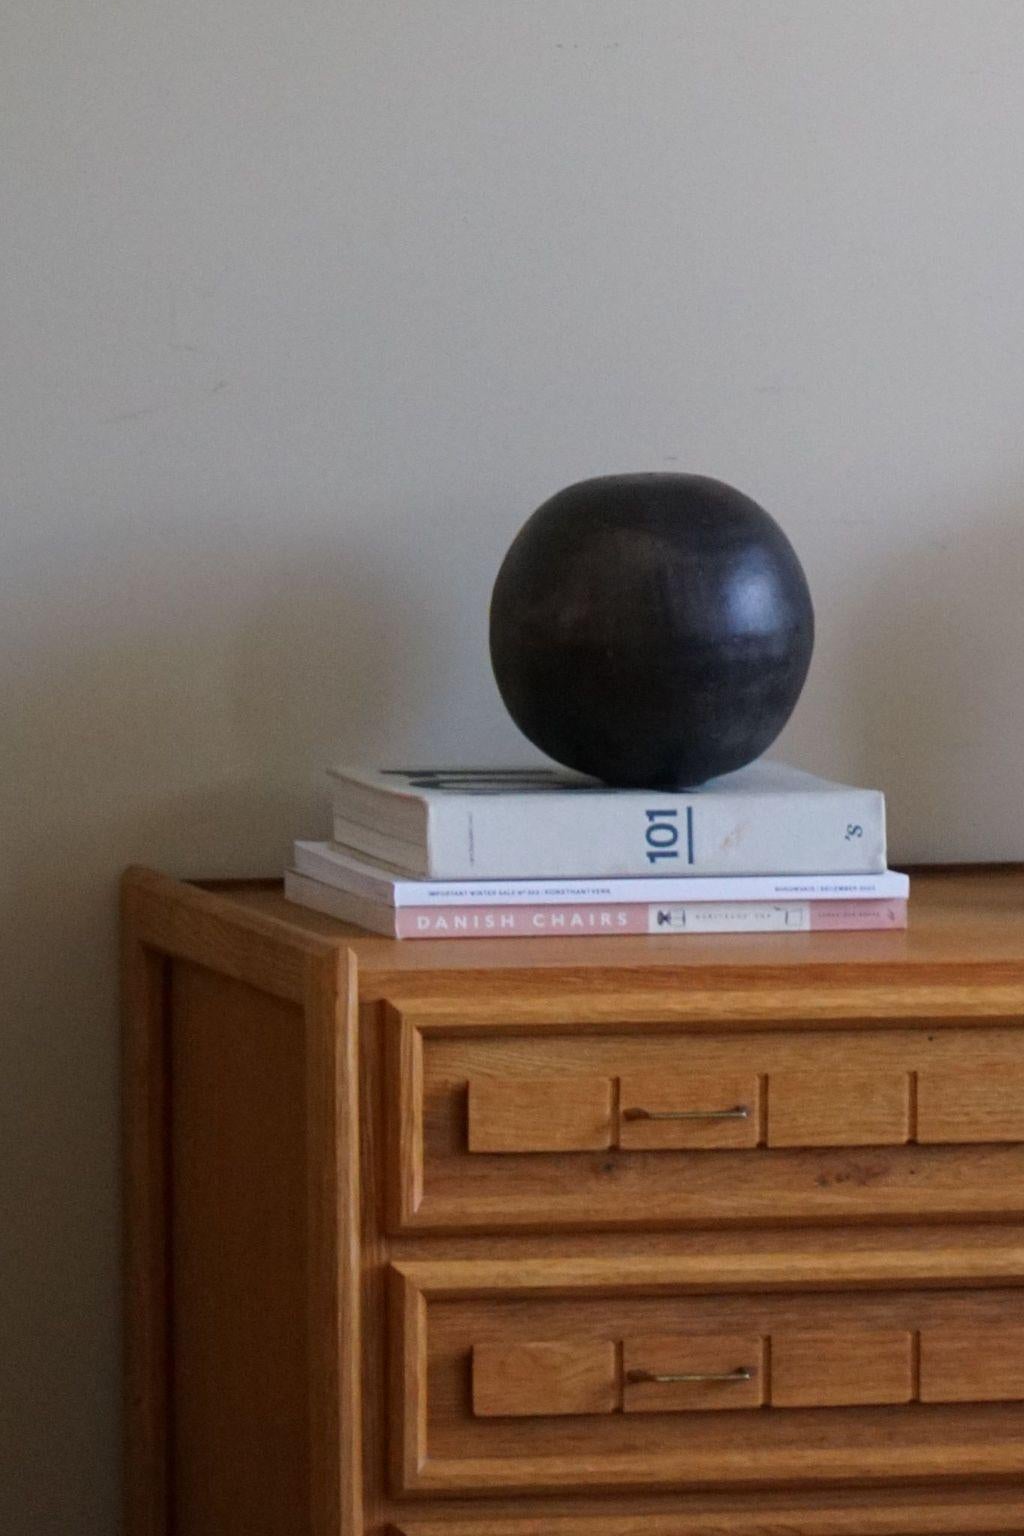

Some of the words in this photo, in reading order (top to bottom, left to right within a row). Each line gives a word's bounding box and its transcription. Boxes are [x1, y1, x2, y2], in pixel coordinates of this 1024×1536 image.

[645, 808, 679, 864] 101
[417, 913, 515, 930] DANISH
[532, 911, 628, 927] CHAIRS
